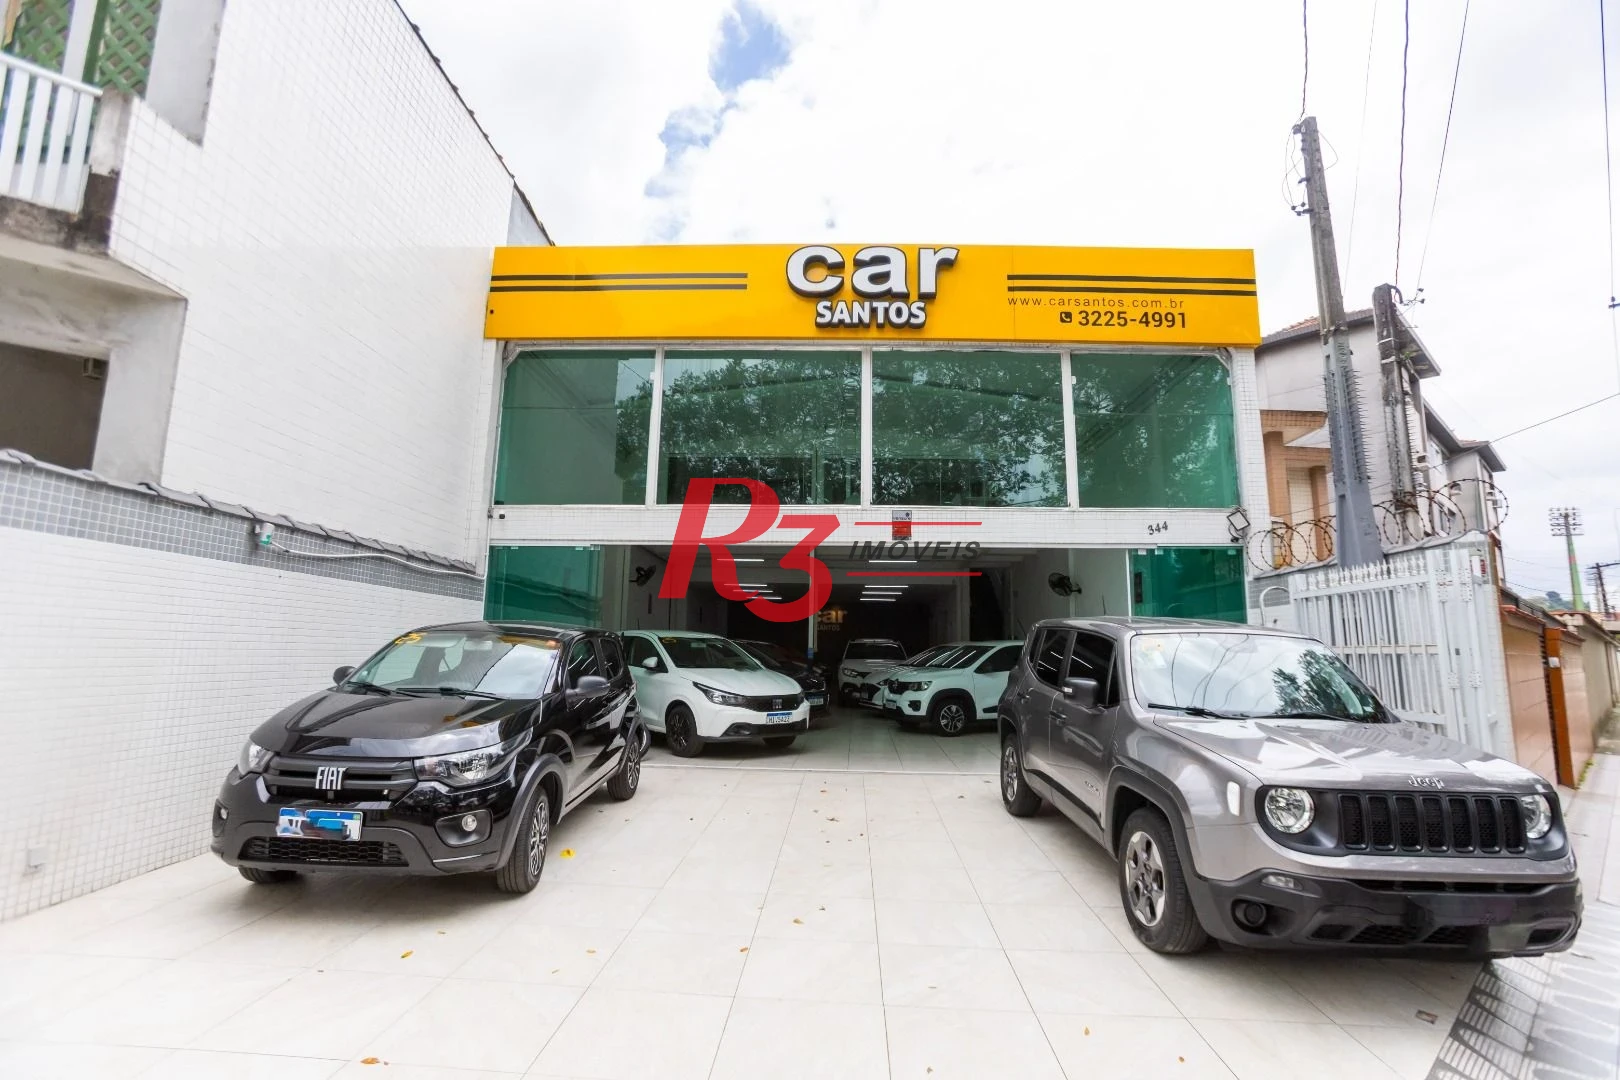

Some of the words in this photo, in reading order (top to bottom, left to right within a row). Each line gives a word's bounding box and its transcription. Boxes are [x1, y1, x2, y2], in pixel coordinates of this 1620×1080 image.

[786, 245, 960, 300] car
[1008, 296, 1184, 309] www.carsantos.com.br
[815, 300, 927, 329] SANTOS
[1078, 310, 1186, 328] 3225-4991
[1147, 520, 1169, 536] 344
[315, 766, 347, 790] FIAT
[1408, 775, 1445, 790] Jeep
